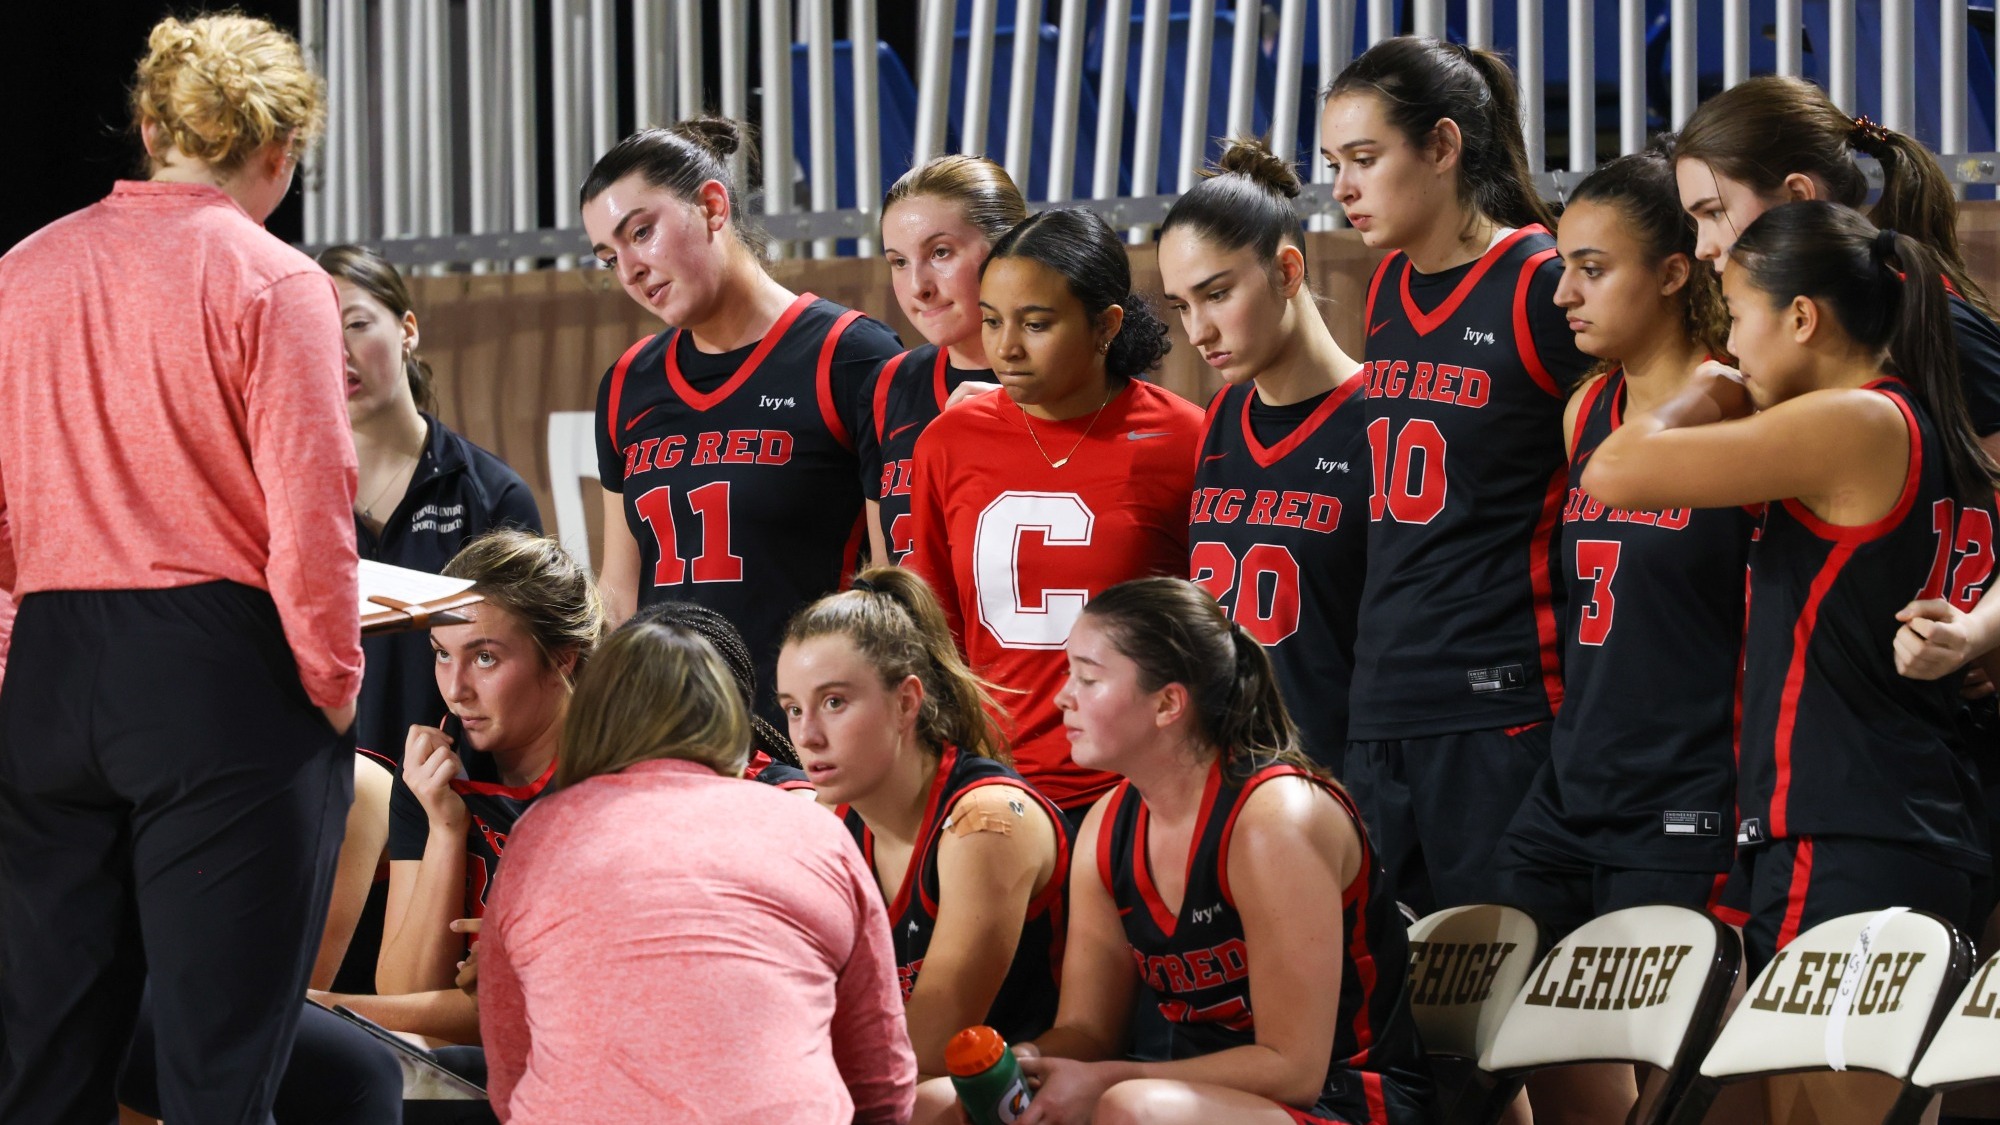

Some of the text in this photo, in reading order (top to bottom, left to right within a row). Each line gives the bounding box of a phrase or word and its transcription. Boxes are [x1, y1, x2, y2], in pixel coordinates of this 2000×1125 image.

[1463, 327, 1484, 345] Ivy
[759, 395, 783, 410] Ivy
[1409, 361, 1491, 409] RED
[623, 430, 794, 480] BIG RED
[1315, 457, 1338, 473] Ivy
[1367, 417, 1447, 525] 10
[635, 481, 743, 587] 11
[1246, 490, 1343, 534] RED
[973, 490, 1095, 650] C
[1914, 497, 1996, 614] 12
[1190, 541, 1301, 646] 20
[1576, 540, 1622, 646] 3
[1508, 672, 1516, 682] L
[1704, 818, 1712, 829] L
[1748, 825, 1757, 837] M
[1164, 937, 1249, 993] RED
[1407, 942, 1517, 1006] EHIGH
[1525, 945, 1692, 1011] LEHIGH
[1750, 951, 1926, 1016] LEHGH
